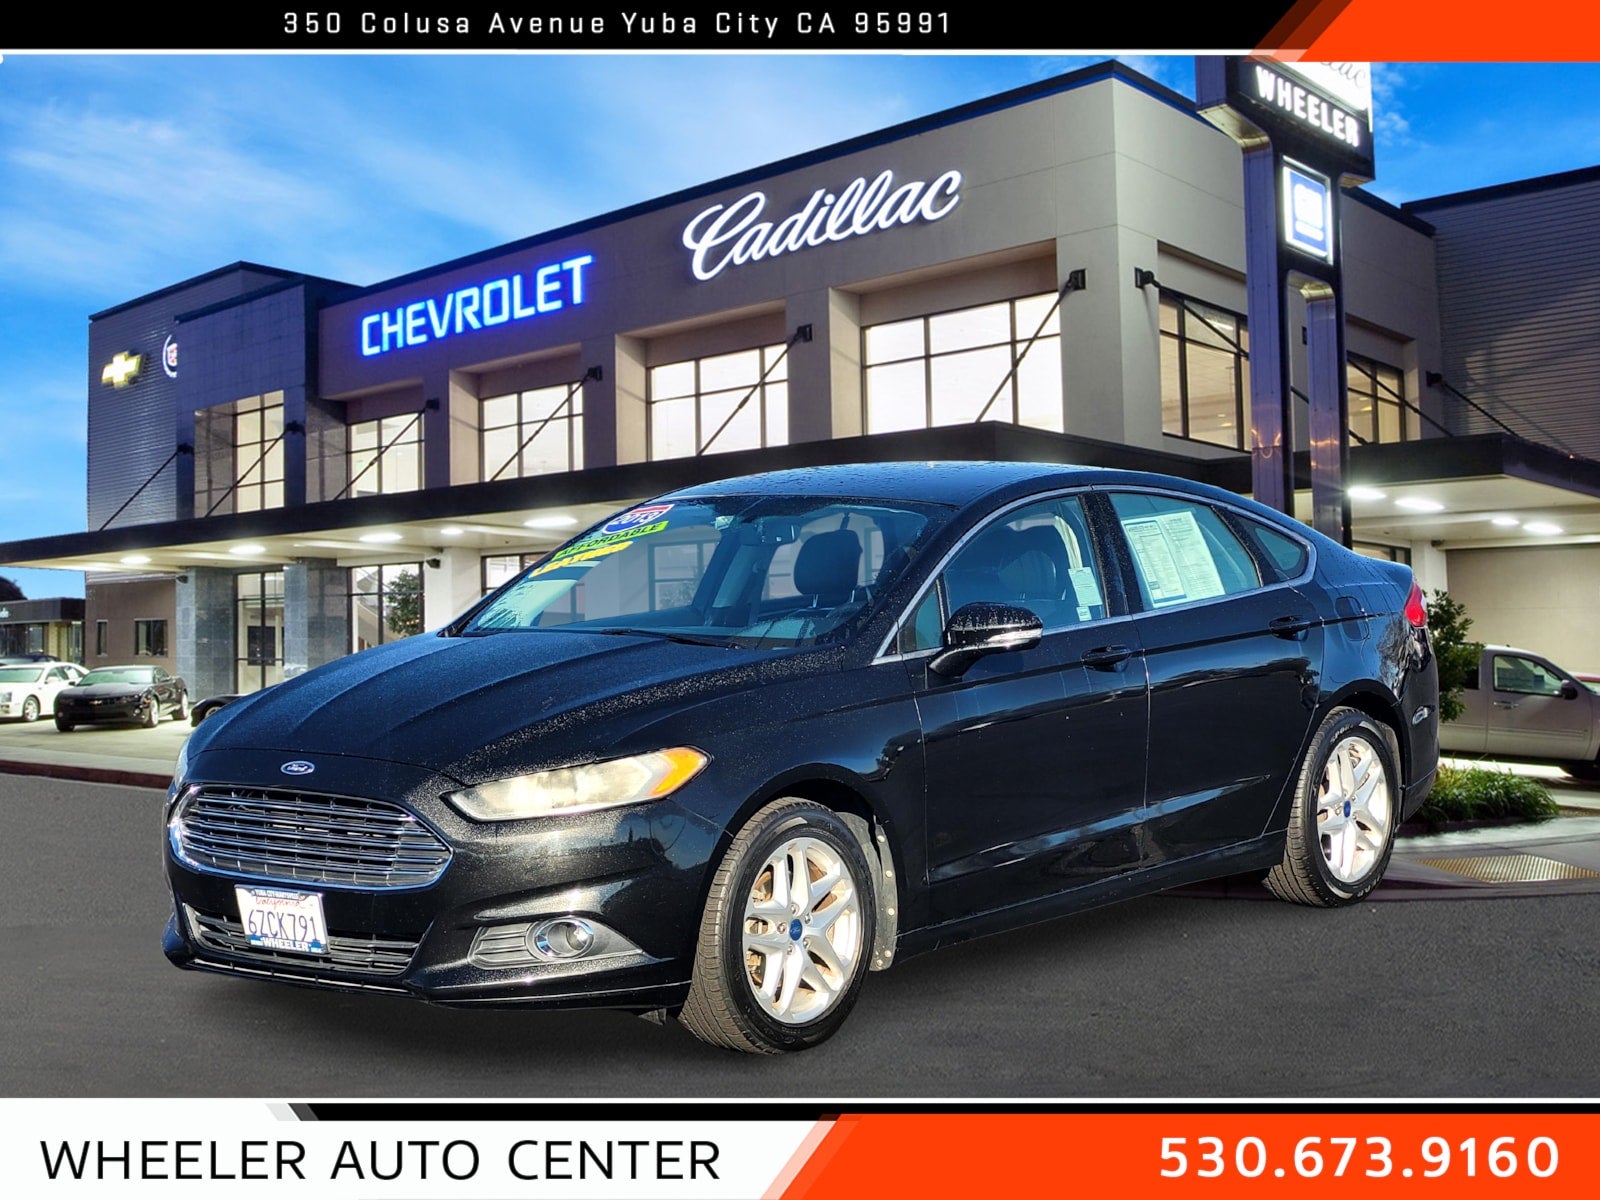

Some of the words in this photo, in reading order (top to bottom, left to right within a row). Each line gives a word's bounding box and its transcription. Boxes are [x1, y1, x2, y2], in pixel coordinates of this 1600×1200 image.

[1255, 64, 1360, 148] WHEELER
[682, 169, 962, 281] Cadillac
[361, 254, 594, 357] CHEVROLET
[562, 523, 660, 557] AFFORDABLE
[248, 909, 318, 942] 6ZCK791
[263, 937, 309, 953] WHEELER
